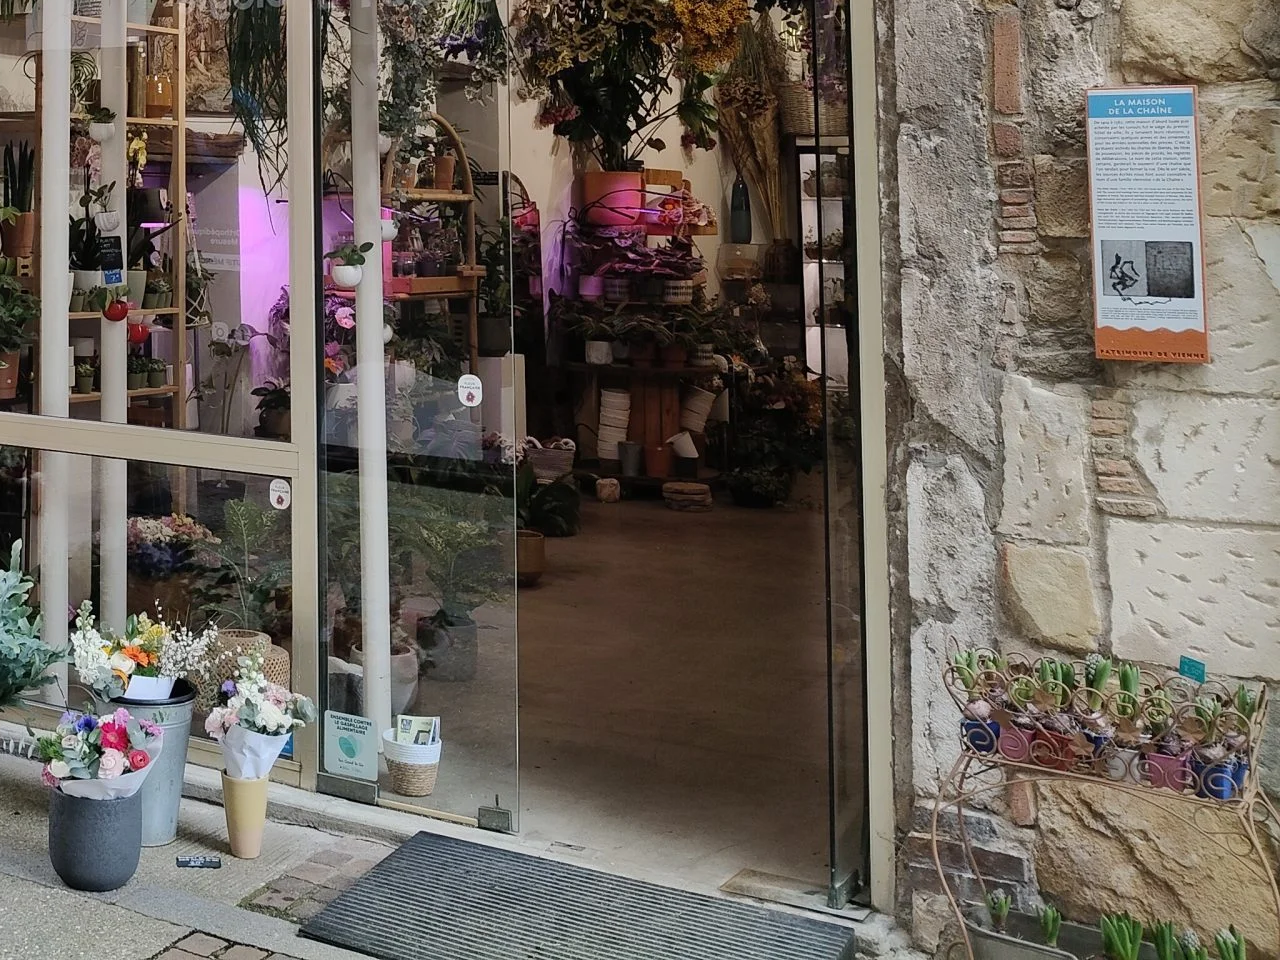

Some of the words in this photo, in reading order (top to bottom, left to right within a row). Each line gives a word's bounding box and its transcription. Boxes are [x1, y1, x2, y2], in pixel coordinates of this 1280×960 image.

[1127, 98, 1166, 106] MAISON
[1123, 107, 1134, 115] LA
[1137, 106, 1173, 115] CHAÎNE
[1100, 349, 1153, 358] PATRIMOINE
[330, 714, 353, 723] ENSEMBLE
[353, 718, 373, 727] CONTRE
[336, 725, 366, 736] ALIMENTAIRE
[340, 721, 369, 731] GASPILLAGE
